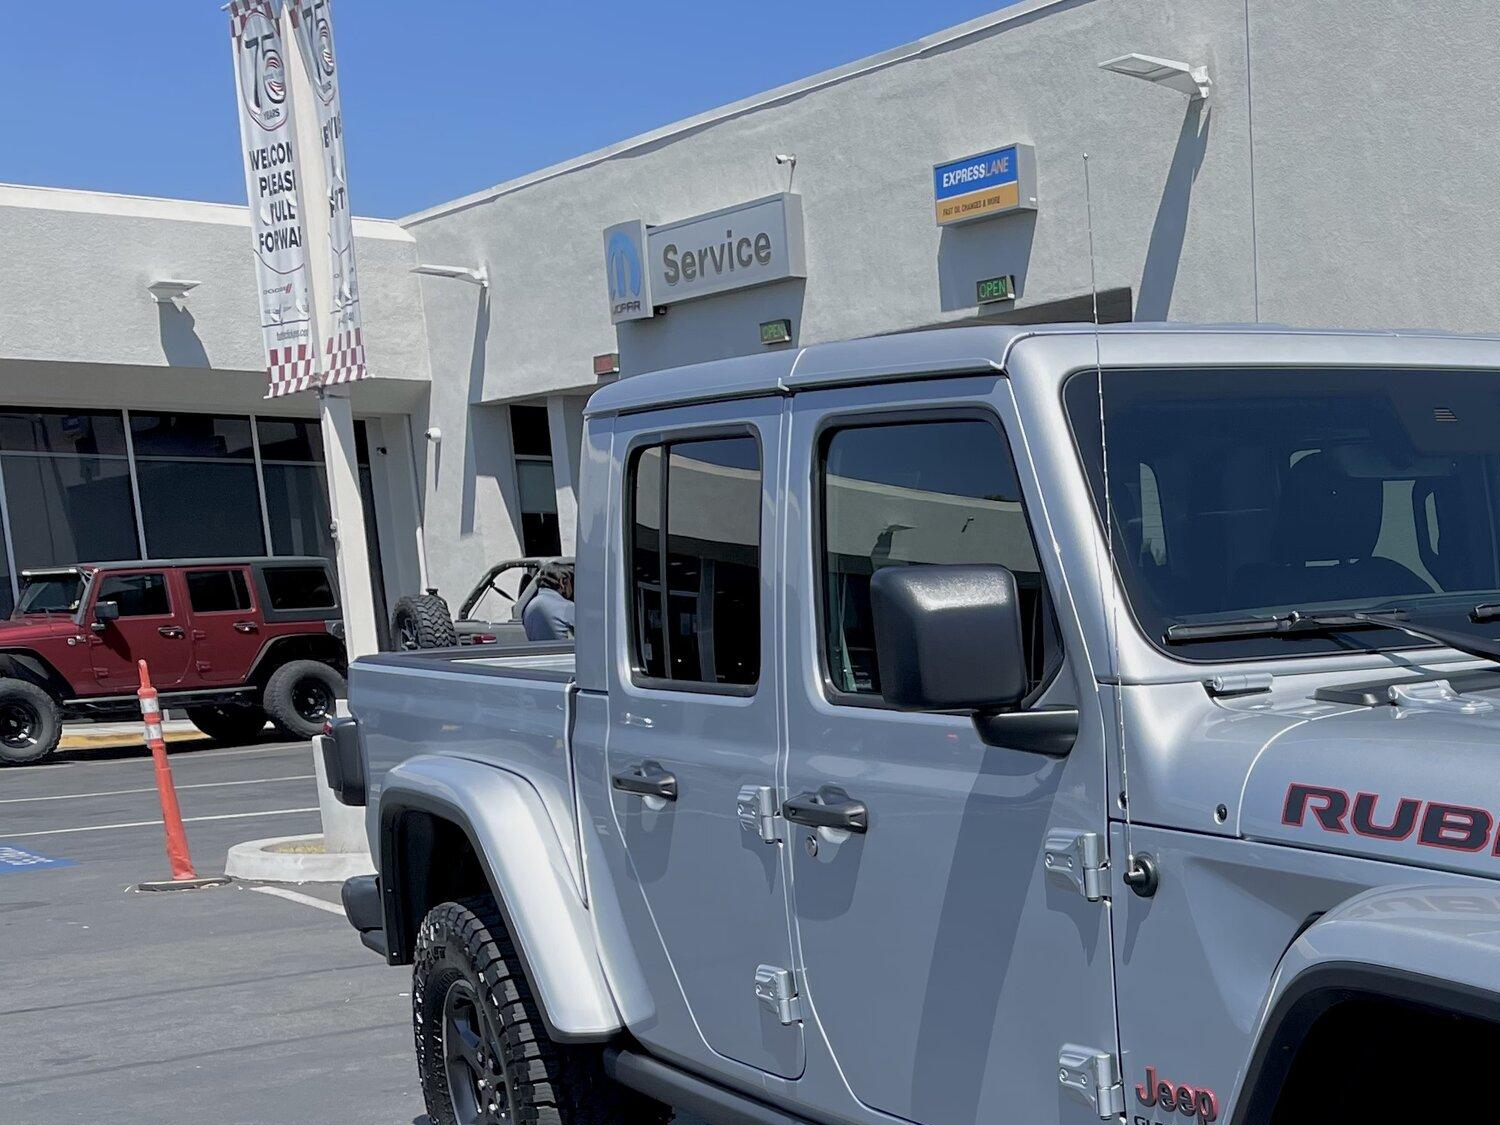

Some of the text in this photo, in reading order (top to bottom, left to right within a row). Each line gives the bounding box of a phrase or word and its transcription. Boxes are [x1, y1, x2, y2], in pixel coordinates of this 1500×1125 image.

[259, 226, 302, 254] FORWA
[663, 229, 772, 287] Service
[980, 279, 1006, 298] OPEN
